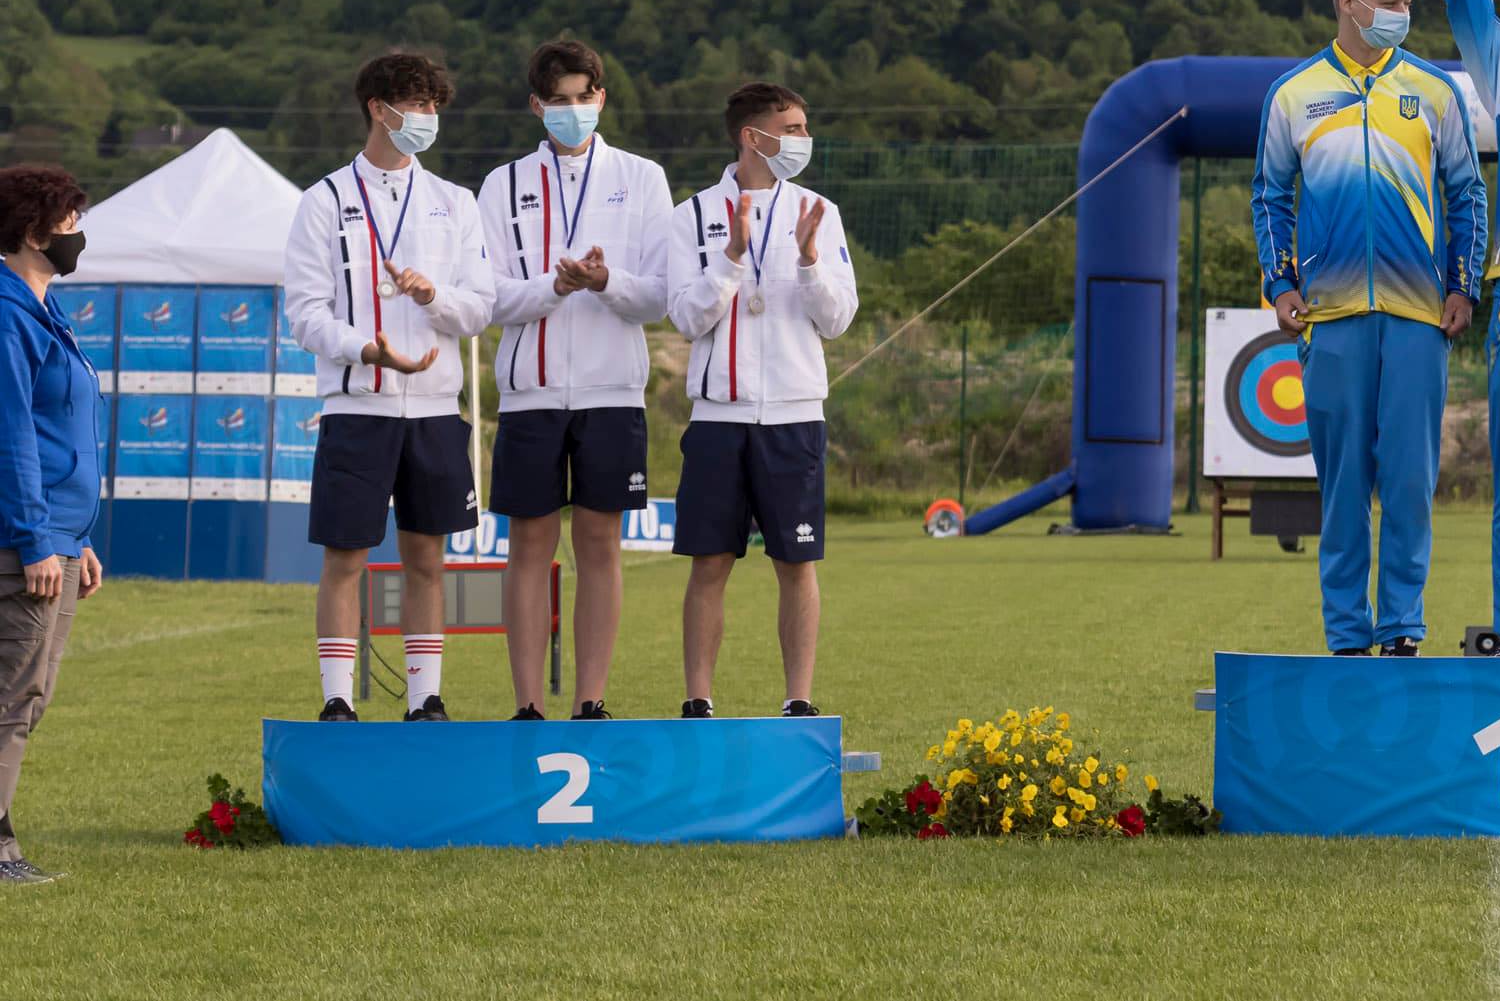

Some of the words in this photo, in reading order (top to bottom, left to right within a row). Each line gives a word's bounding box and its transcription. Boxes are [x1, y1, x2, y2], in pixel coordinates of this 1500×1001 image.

[1305, 100, 1335, 109] UKRAINIAN
[1308, 106, 1333, 114] ARCHERY
[1306, 110, 1338, 120] FEDERATION
[537, 752, 594, 824] 2
